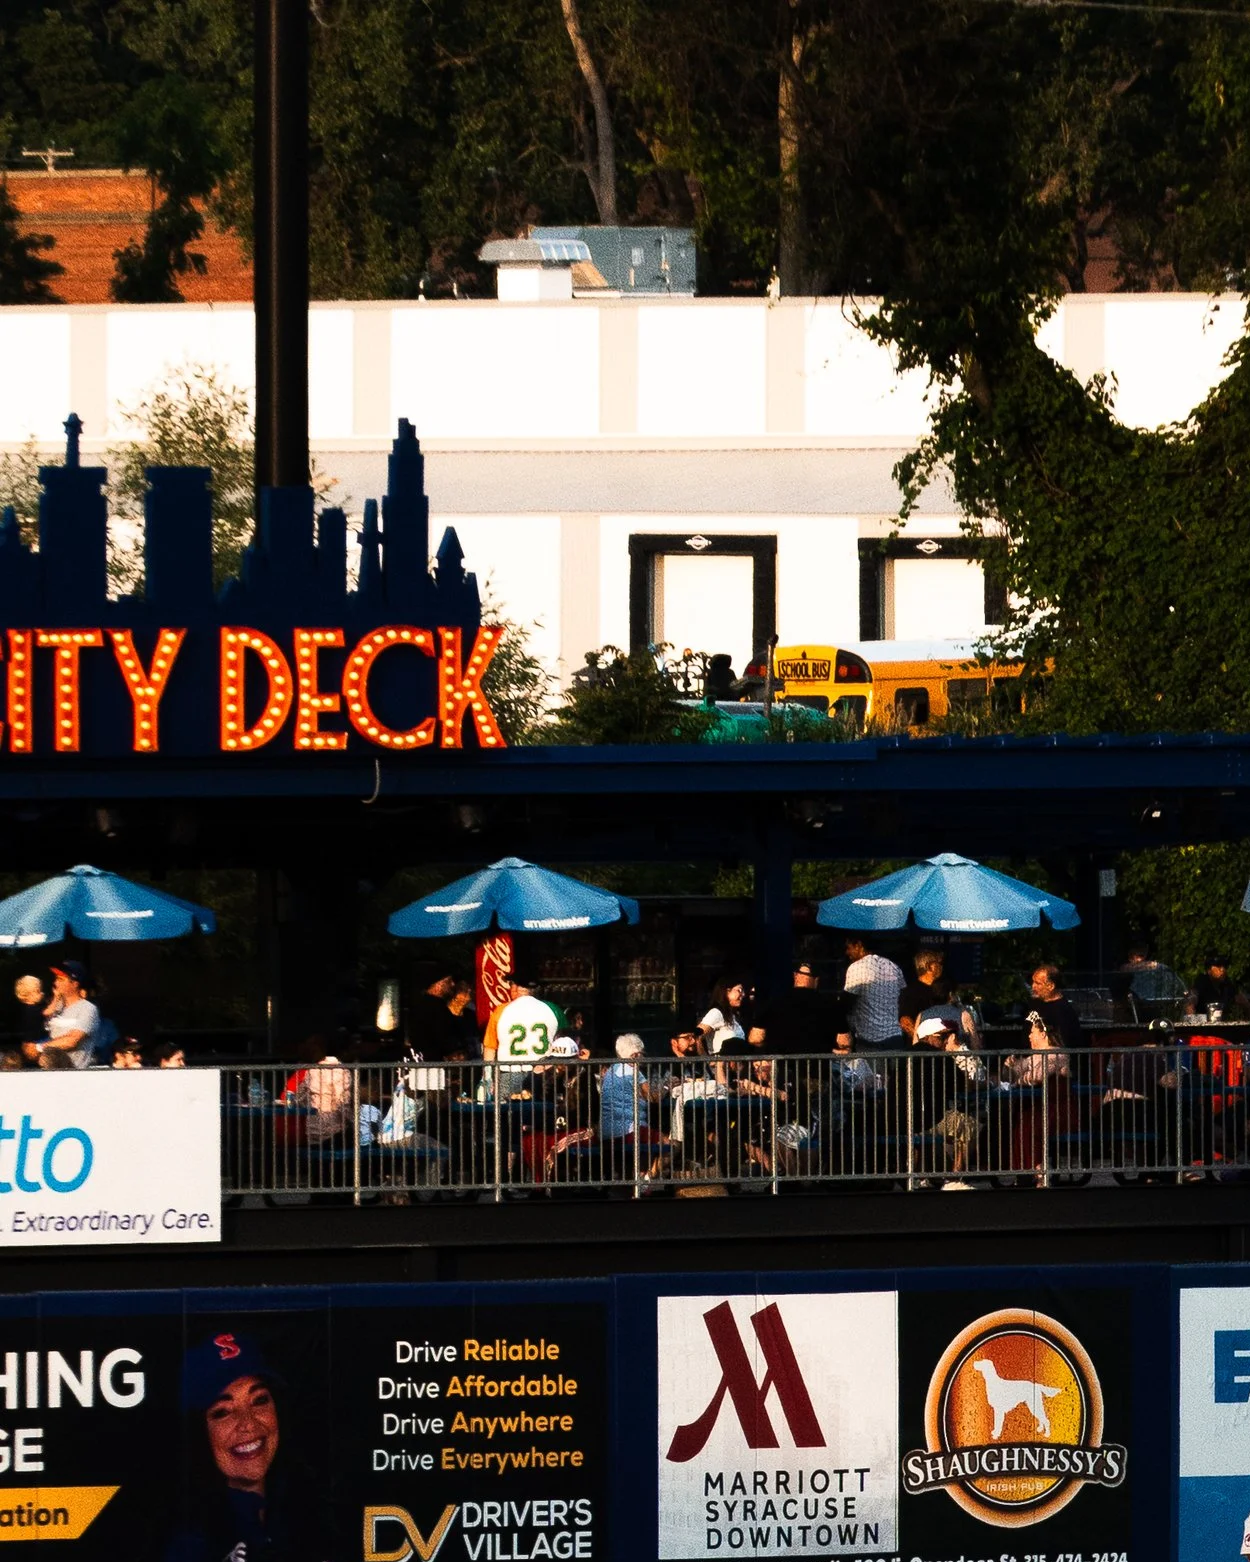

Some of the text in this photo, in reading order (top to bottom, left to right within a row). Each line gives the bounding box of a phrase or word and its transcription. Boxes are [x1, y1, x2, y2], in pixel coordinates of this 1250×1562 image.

[781, 662, 827, 678] SCHOOL BUS
[0, 625, 508, 753] ITY DECK
[523, 916, 590, 929] smartwater
[939, 919, 1009, 930] smartwater
[509, 1023, 549, 1056] 23
[12, 1208, 214, 1235] Extraordinary Care.
[213, 1334, 241, 1360] S
[396, 1339, 560, 1363] Drive Reliable
[378, 1374, 578, 1400] Drive Affordable
[383, 1411, 574, 1439] Drive Anywhere
[373, 1447, 584, 1475] Drive Everywhere
[907, 1447, 1121, 1486] SHAUGHNESSY'S
[704, 1468, 870, 1497] MARRIOTT
[986, 1481, 1045, 1492] IRISH PUB
[462, 1498, 593, 1528] DRIVER'S
[705, 1497, 857, 1523] SYRACUSE
[462, 1530, 593, 1561] VILLAGE
[706, 1523, 879, 1550] DOWNTOWN
